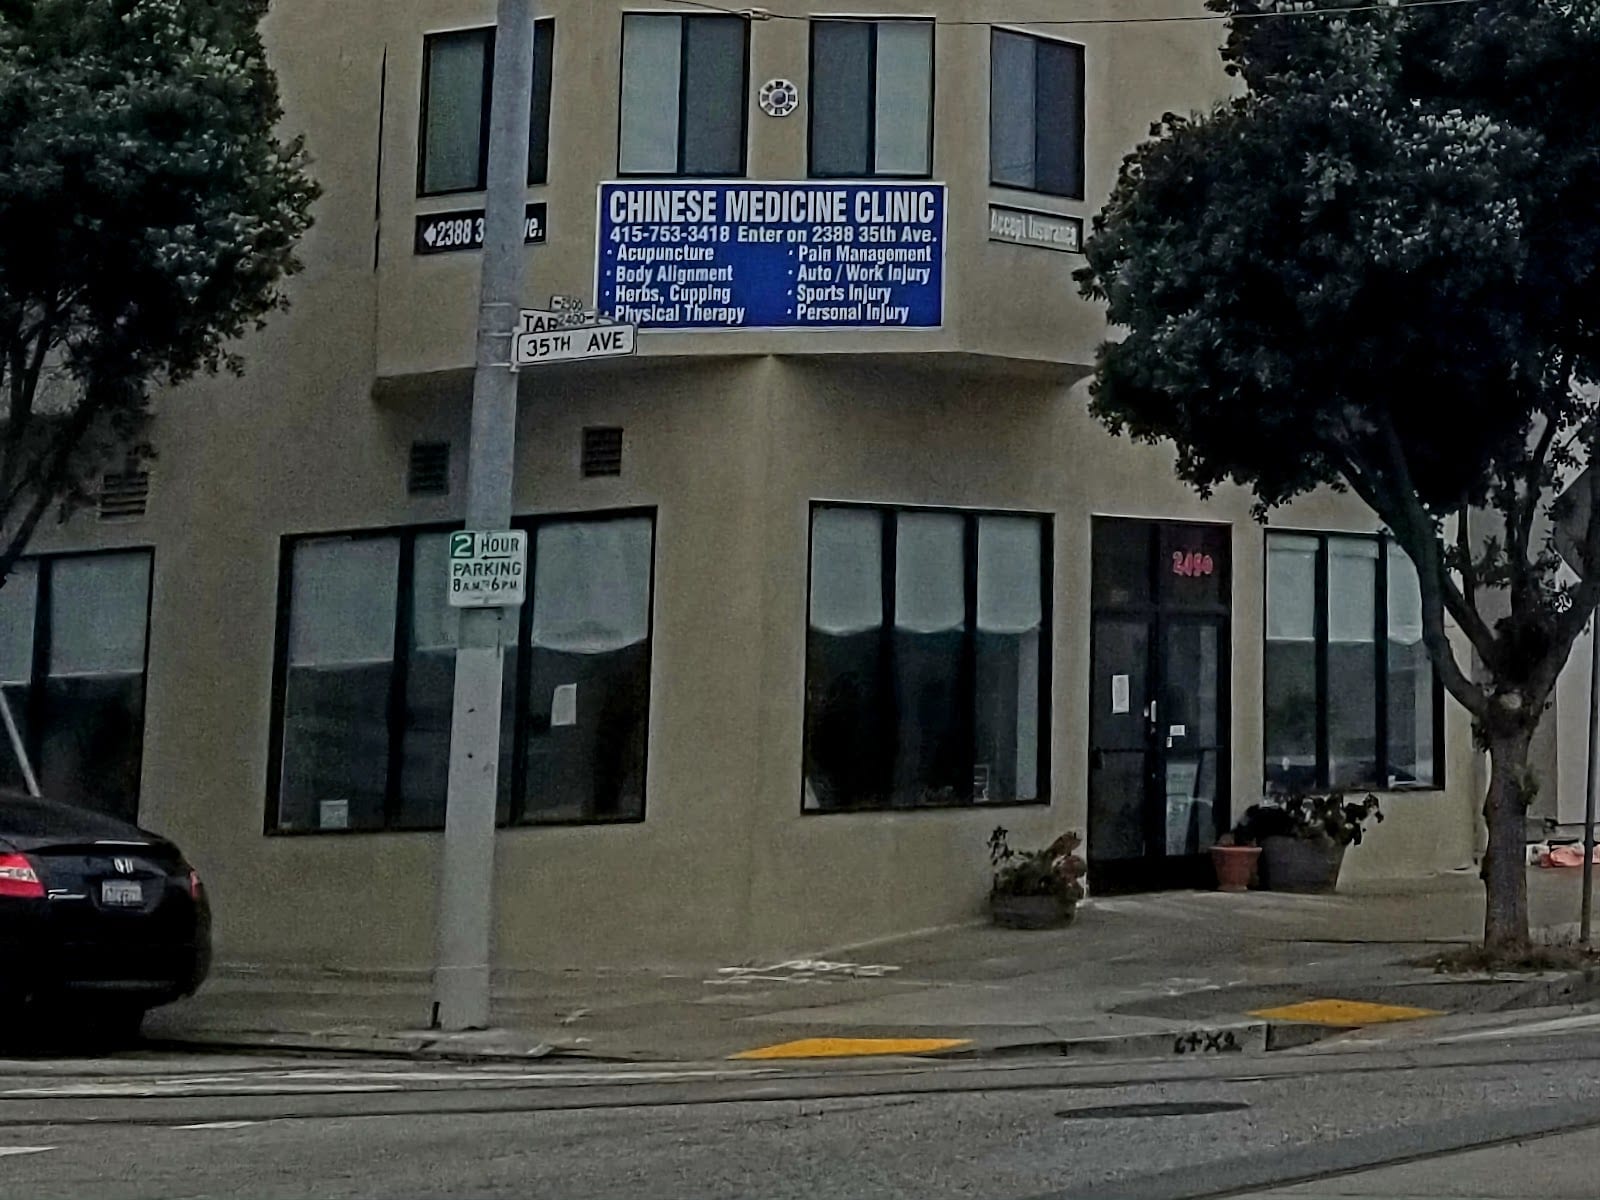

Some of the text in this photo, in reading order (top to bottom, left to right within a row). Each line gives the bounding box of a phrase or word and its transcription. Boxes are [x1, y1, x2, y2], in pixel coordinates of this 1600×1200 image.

[610, 190, 935, 223] CHINESE MEDICINE CLINIC
[435, 218, 472, 247] 2388
[609, 225, 938, 243] 415-753-3418 Enter on 2388 35th Ave.
[616, 243, 715, 265] Acupuncture
[798, 245, 932, 265] Pain Management
[615, 265, 734, 287] Body Alignment
[797, 264, 931, 285] Auto / Work Injury
[615, 284, 732, 305] Herbs, Cupping
[796, 284, 892, 305] Sports Injury
[522, 314, 559, 332] TAR
[615, 304, 745, 324] Physical Therapy
[796, 304, 909, 324] Personal Injury
[525, 331, 625, 357] 35TH AVE
[453, 534, 520, 557] 2 HOUR
[453, 561, 522, 577] PARKING
